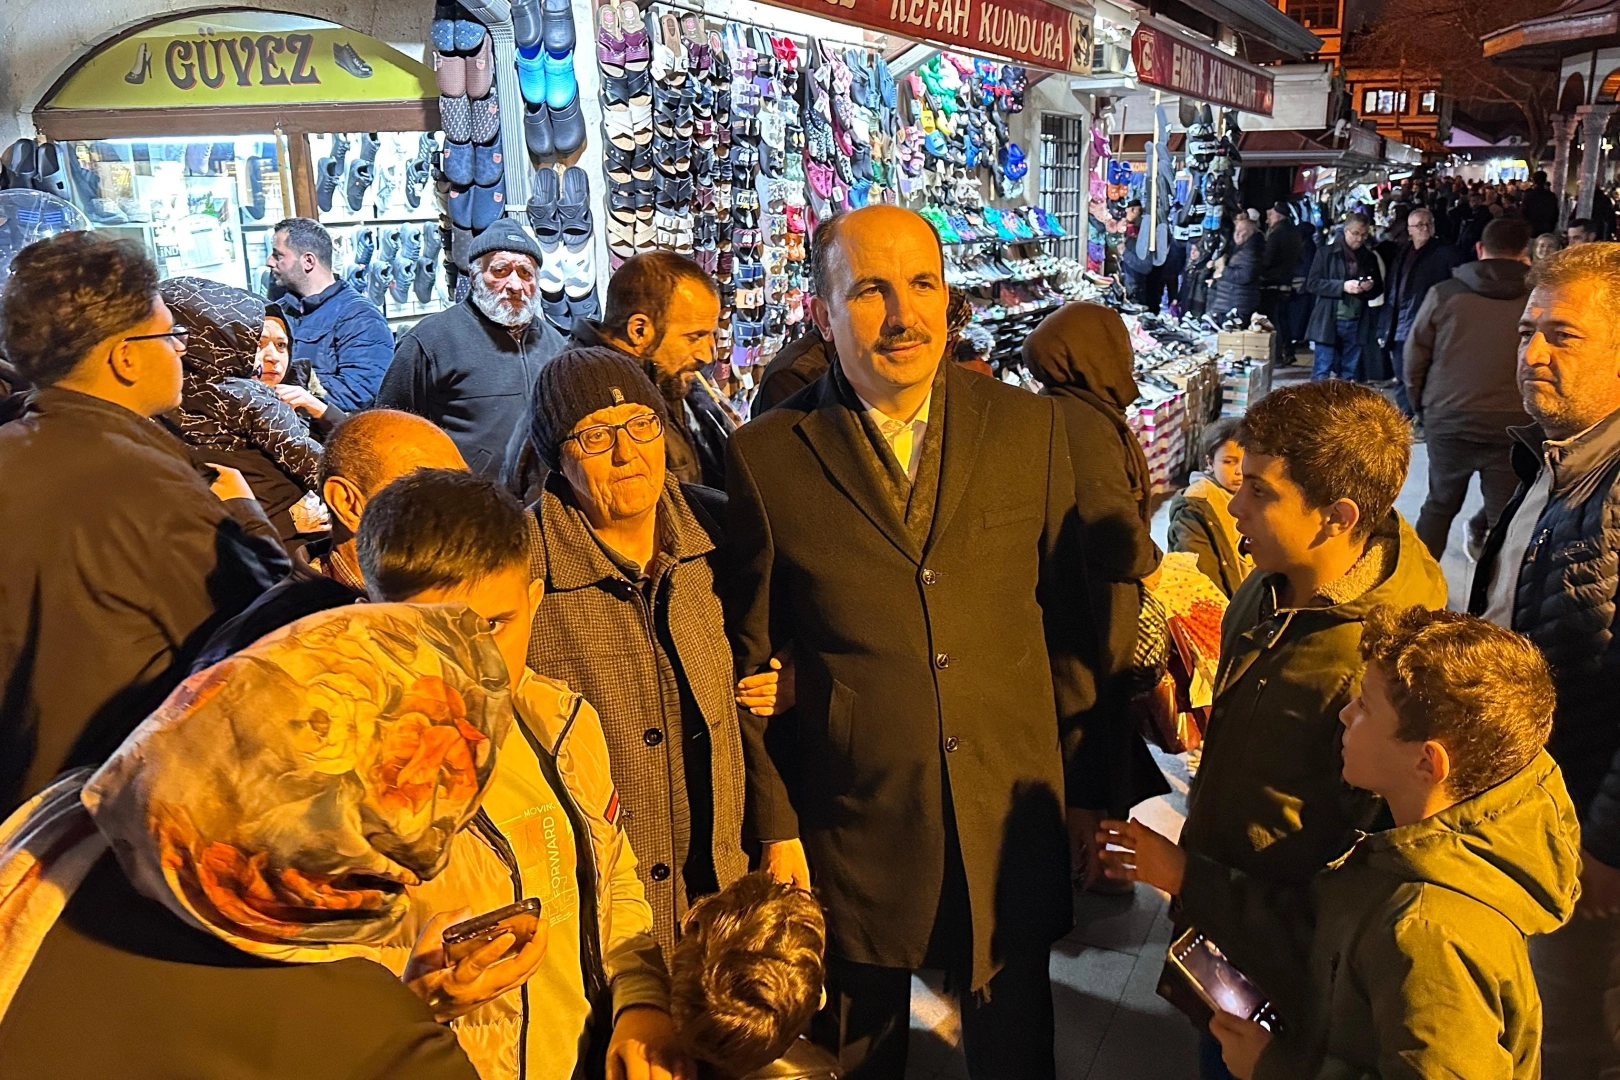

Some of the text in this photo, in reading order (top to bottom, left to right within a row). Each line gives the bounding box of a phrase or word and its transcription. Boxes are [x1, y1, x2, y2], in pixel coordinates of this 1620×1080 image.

[165, 27, 322, 90] GÜVEZ
[979, 2, 1064, 62] KUNDURA
[1208, 59, 1257, 108] KUNDURA
[542, 816, 561, 898] FORWARD
